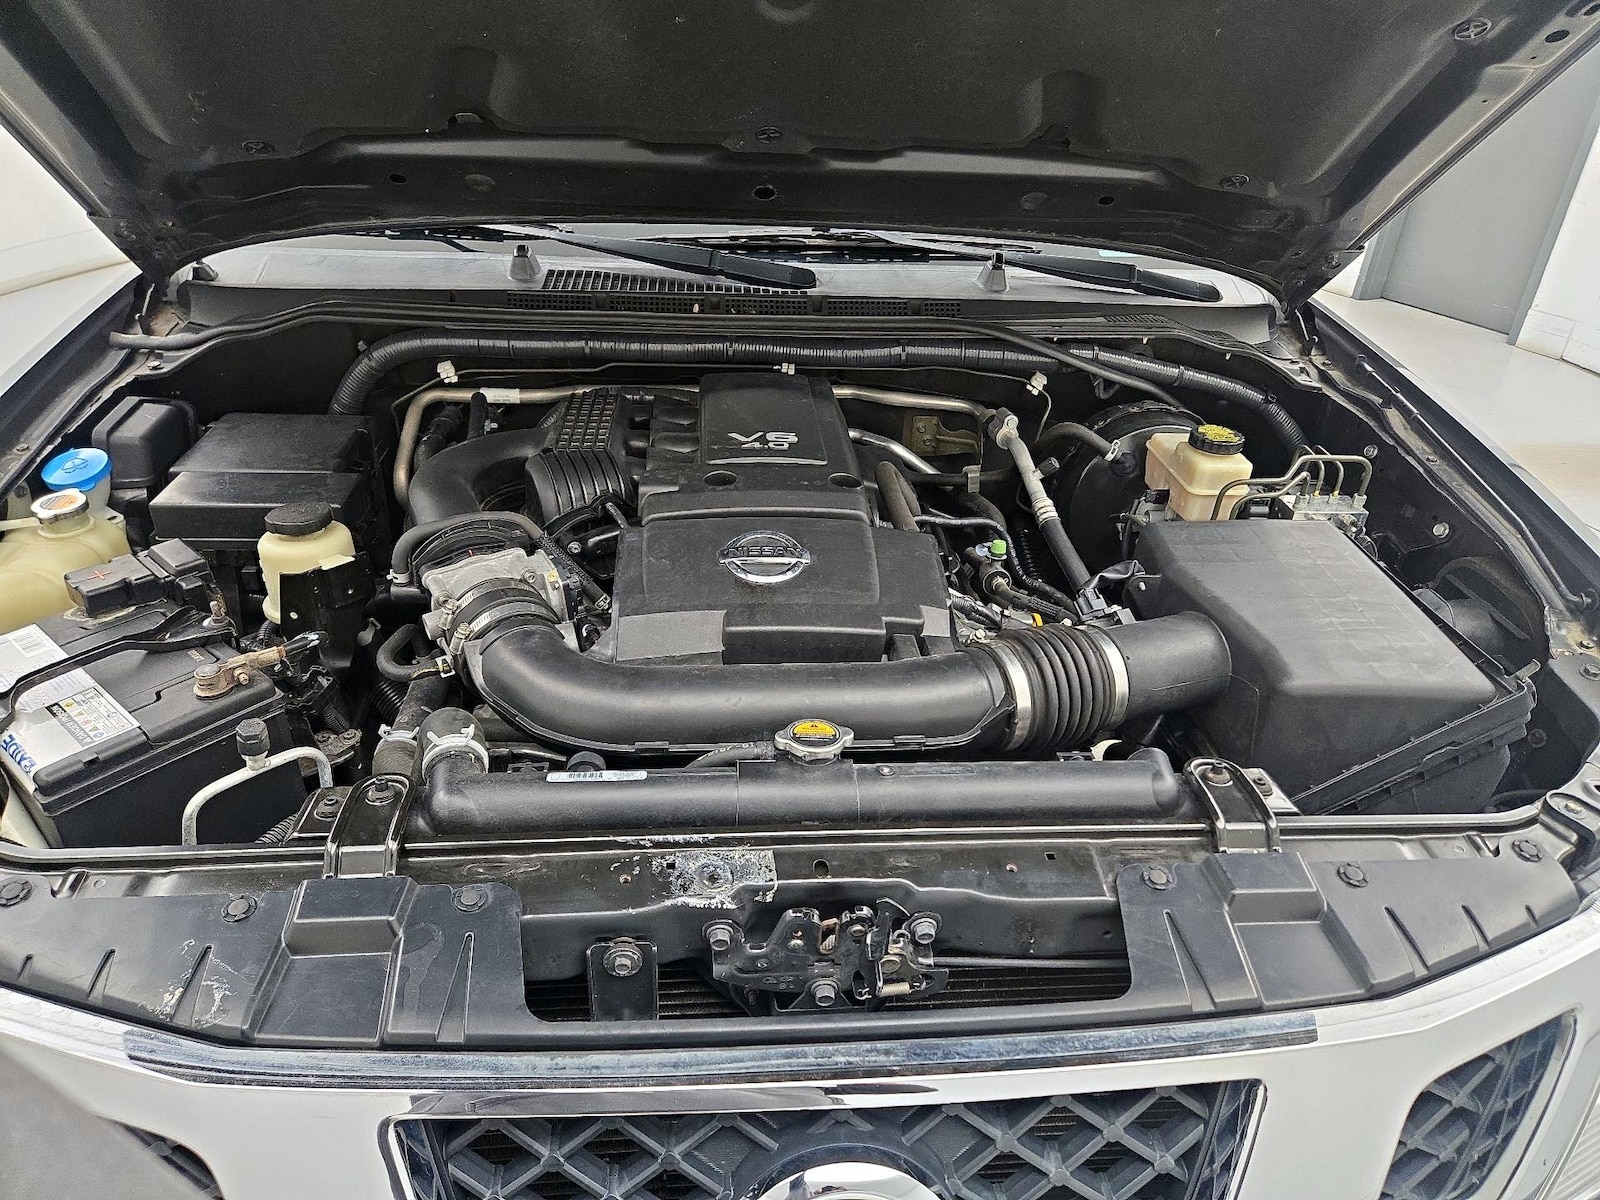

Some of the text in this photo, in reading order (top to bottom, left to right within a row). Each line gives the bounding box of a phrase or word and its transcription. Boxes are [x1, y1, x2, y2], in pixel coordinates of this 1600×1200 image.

[727, 431, 799, 443] V6
[741, 441, 790, 450] 4.0
[724, 545, 802, 558] NISSAN
[2, 734, 37, 774] EXIDE
